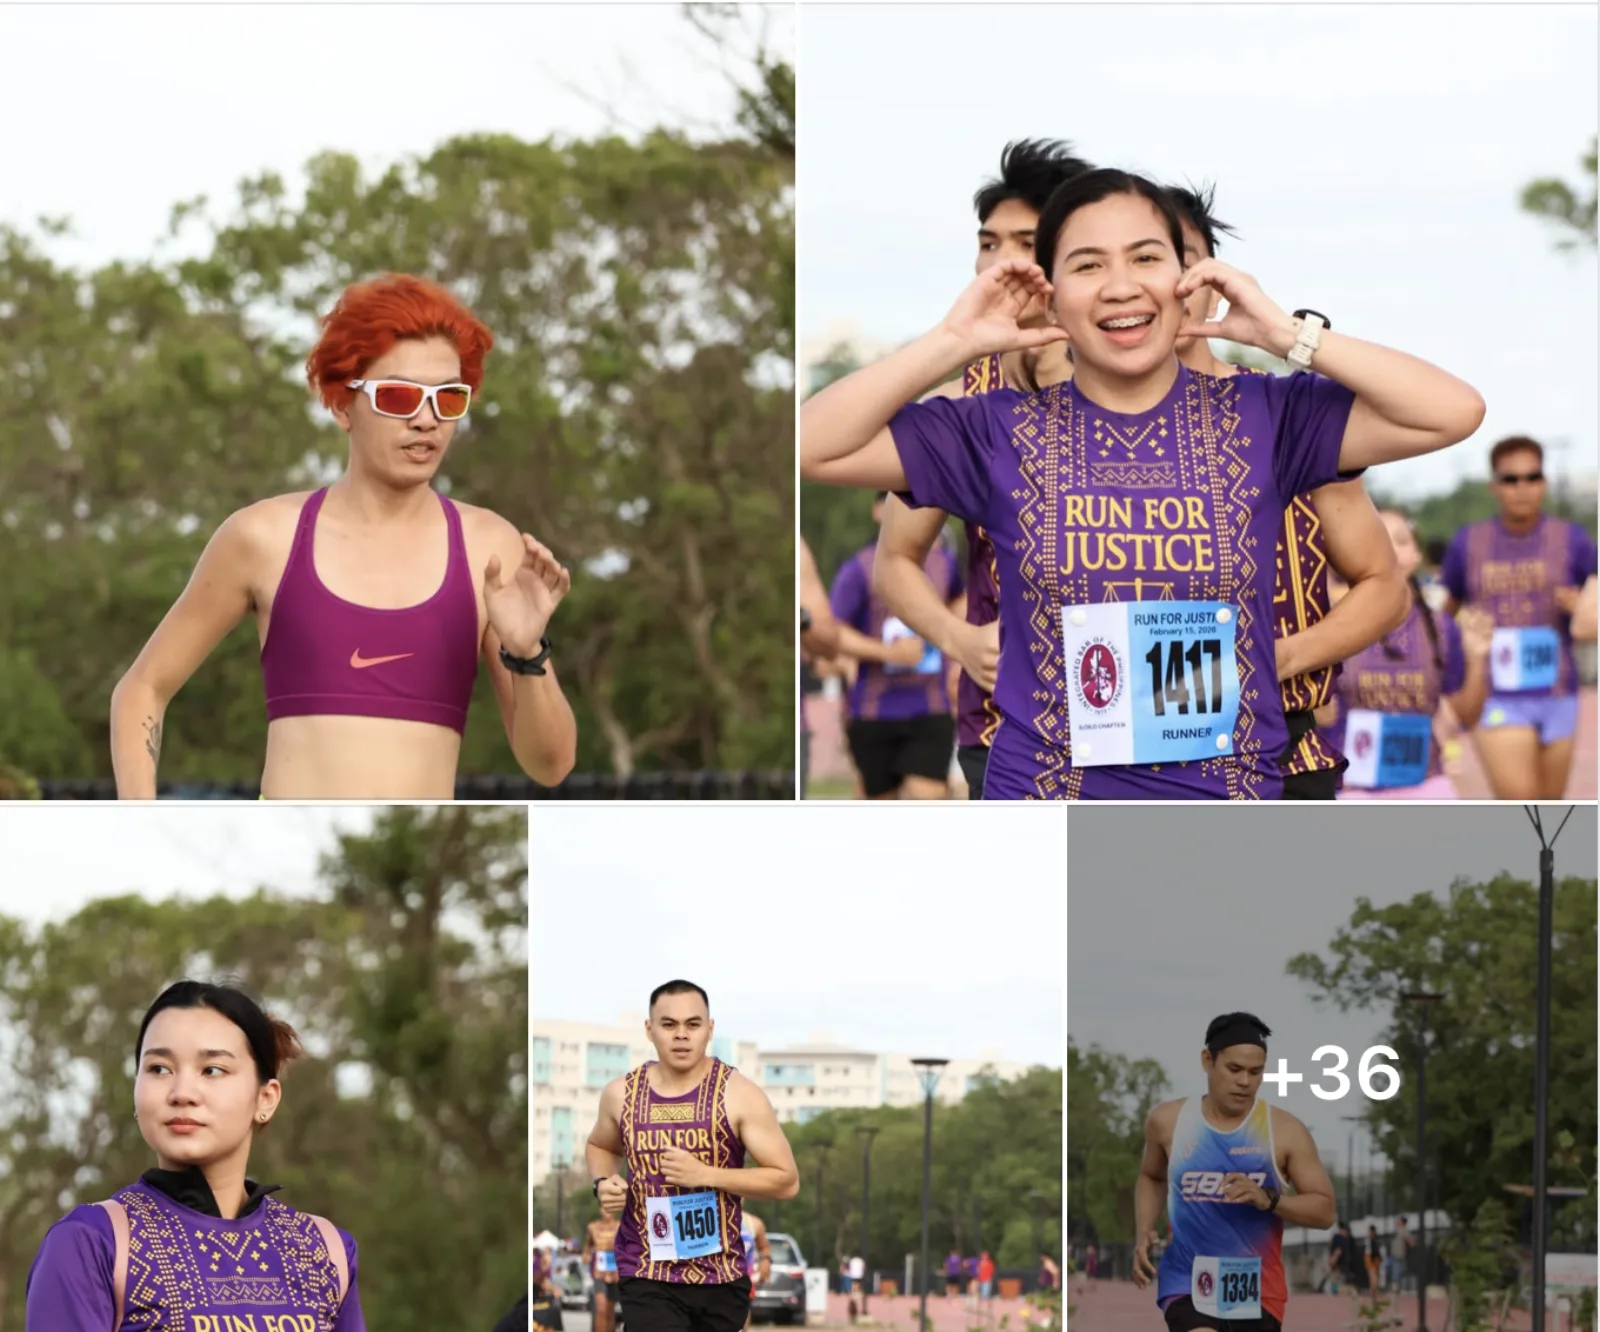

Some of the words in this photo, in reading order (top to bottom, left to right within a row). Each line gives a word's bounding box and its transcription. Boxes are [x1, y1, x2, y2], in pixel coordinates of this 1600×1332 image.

[1064, 495, 1132, 529] RUN
[1143, 496, 1210, 530] FOR
[1060, 532, 1215, 575] JUSTICE
[1134, 613, 1158, 625] RUN
[1160, 612, 1182, 625] FOR
[1184, 611, 1219, 624] JUSTI
[1150, 627, 1183, 637] February
[1185, 627, 1196, 635] 15,
[1198, 626, 1217, 634] 2026
[1077, 640, 1091, 656] BAR
[1107, 641, 1119, 655] THE
[1145, 639, 1222, 716] 1417
[1162, 727, 1212, 740] RUNNER
[636, 1129, 672, 1151] RUN
[675, 1128, 711, 1150] FOR
[675, 1206, 716, 1242] 1450
[1221, 1272, 1259, 1303] 1334
